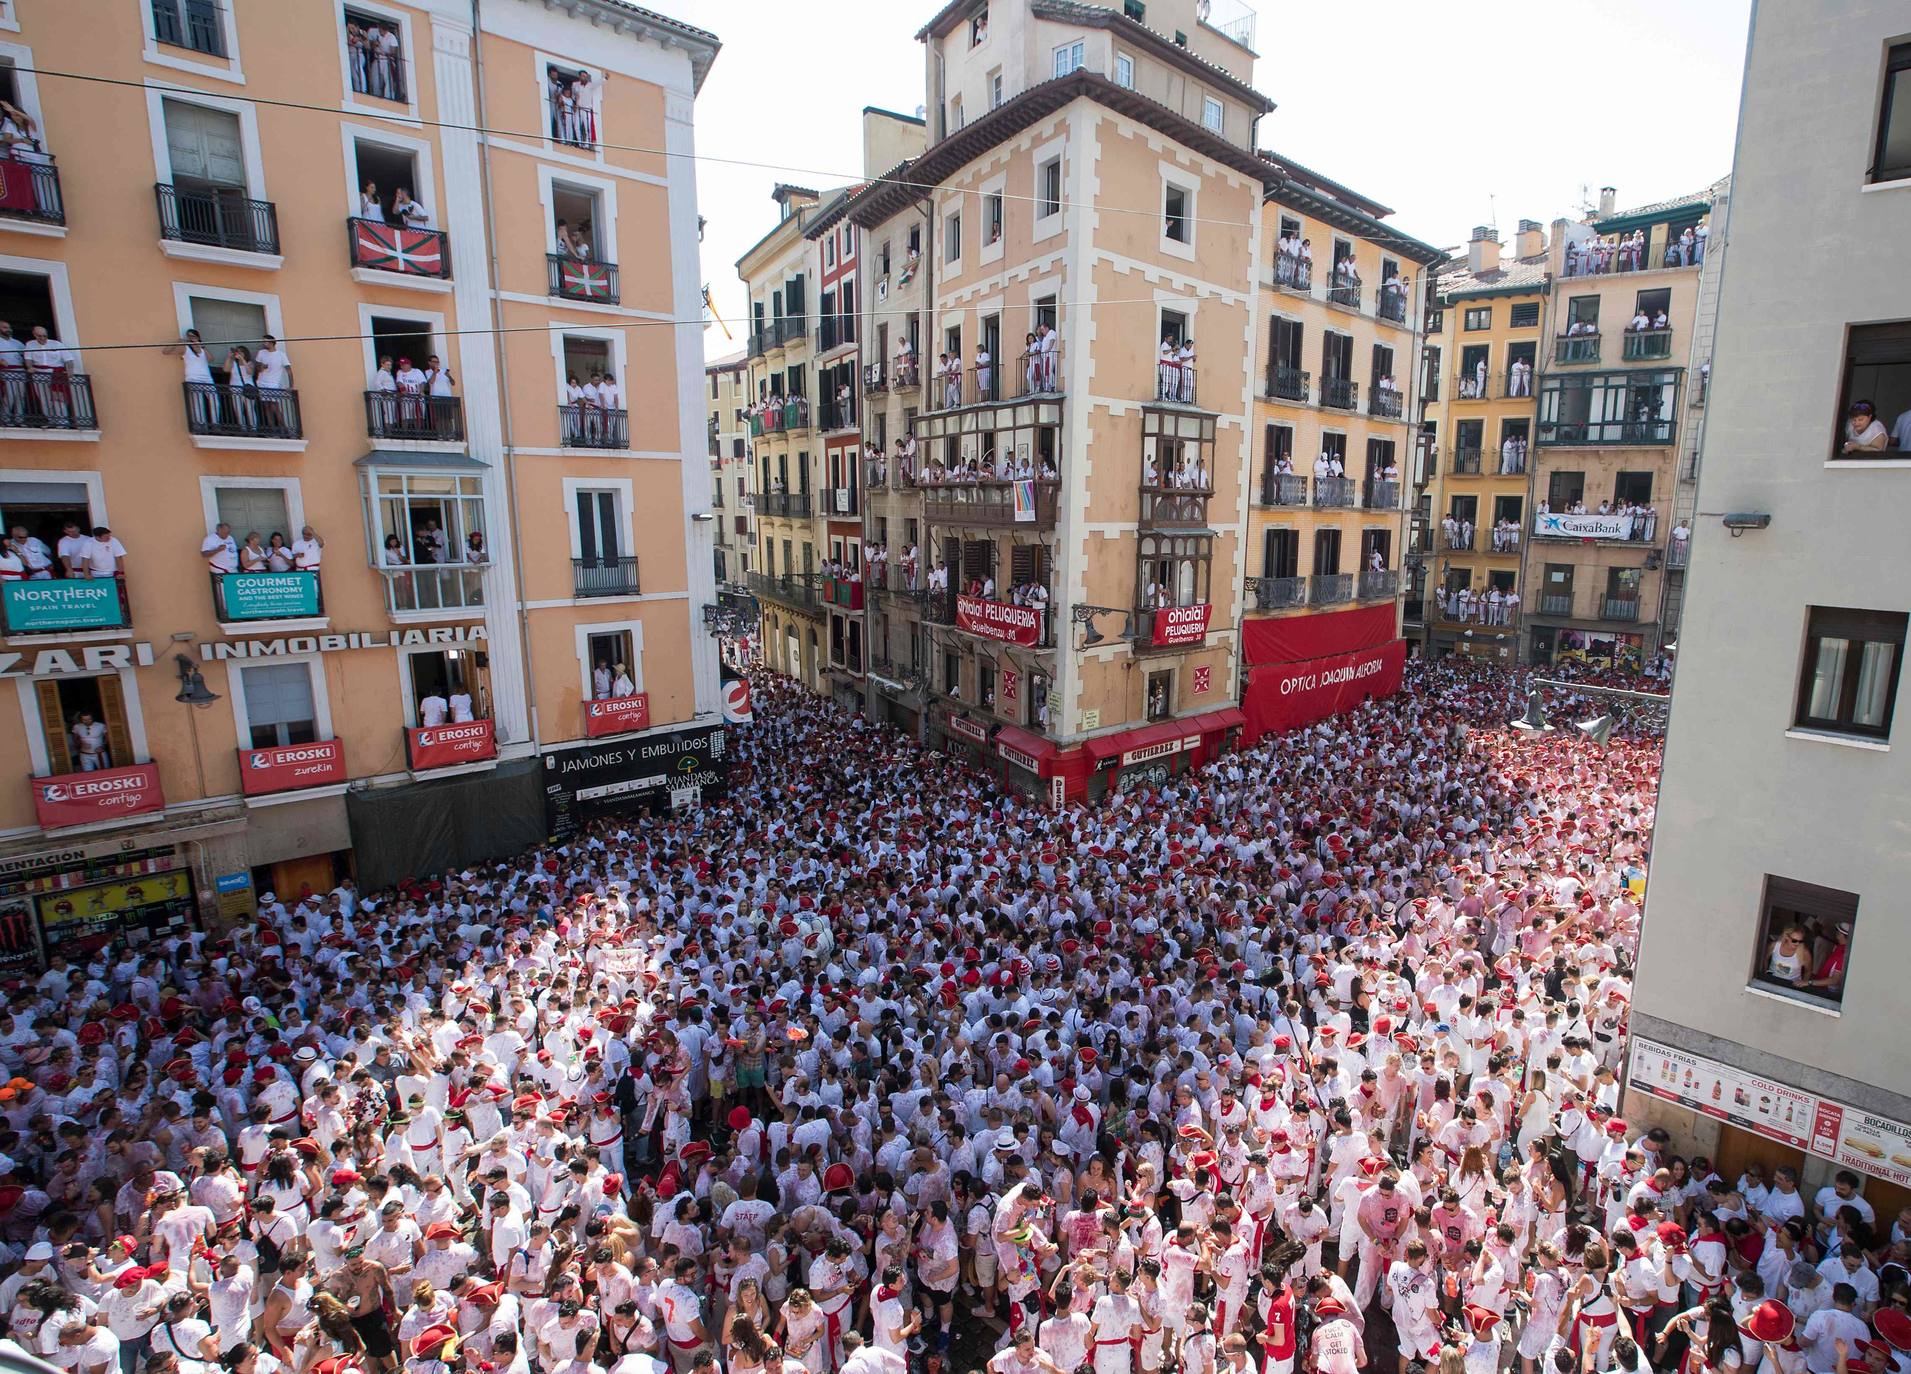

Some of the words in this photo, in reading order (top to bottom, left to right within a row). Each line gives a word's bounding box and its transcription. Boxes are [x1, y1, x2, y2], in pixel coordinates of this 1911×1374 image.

[1563, 520, 1622, 534] CaixaBank
[236, 577, 302, 588] GOURMET
[13, 587, 108, 603] NORTHERN
[237, 586, 304, 596] GASTRONOMY
[1165, 622, 1204, 637] PELUQUERIA
[200, 625, 489, 661] INMOBILIARIA
[1280, 674, 1316, 695] OPTICA
[606, 700, 642, 713] EROSKI
[617, 711, 642, 723] contigo
[438, 726, 484, 742] EROSKI
[275, 748, 332, 765] EROSKI
[1131, 742, 1174, 761] GUTIERREZ
[561, 751, 623, 774] JAMONES
[627, 748, 636, 761] Y
[294, 763, 333, 777] zurekin
[667, 771, 707, 785] VIANDAS
[75, 776, 142, 796] EROSKI
[665, 776, 720, 793] SALAMANCA
[98, 792, 142, 808] contigo
[0, 850, 85, 872] ENTACIÓN
[1638, 1042, 1672, 1058] BEBIDAS
[1751, 1079, 1775, 1092] COLD
[1776, 1088, 1810, 1104] DRINKS
[1841, 1153, 1891, 1178] TRADITIONAL
[1893, 1172, 1910, 1184] HOT
[664, 1297, 675, 1322] 7
[1274, 1312, 1281, 1320] 7
[1330, 1340, 1342, 1348] GET
